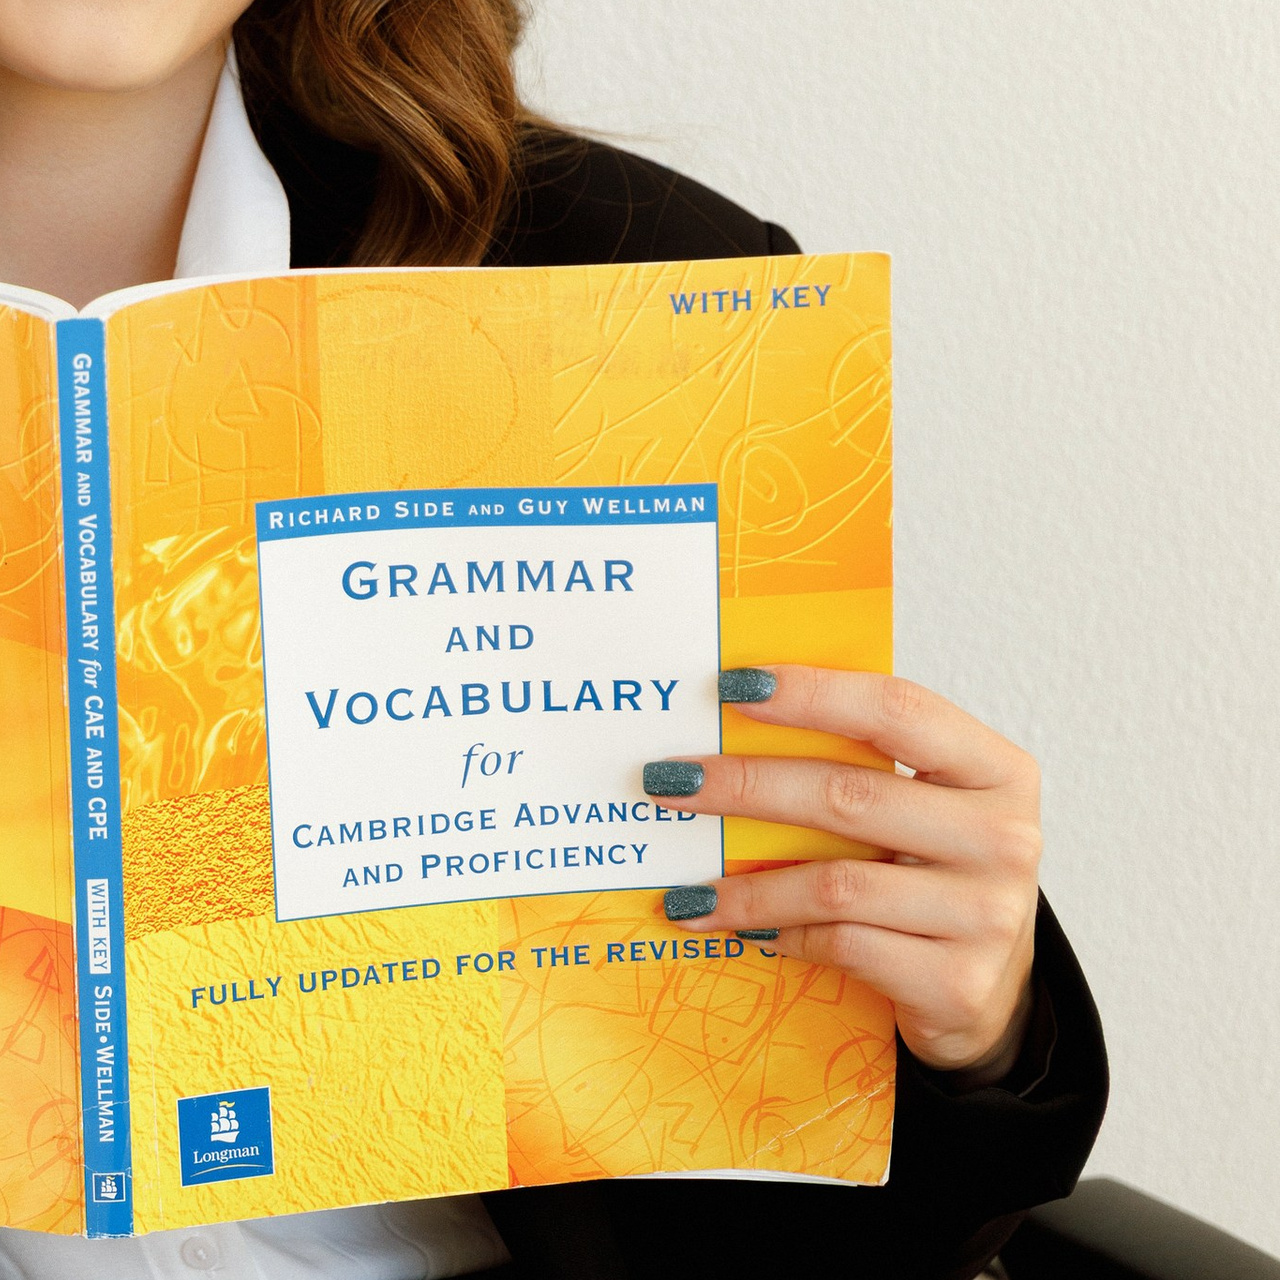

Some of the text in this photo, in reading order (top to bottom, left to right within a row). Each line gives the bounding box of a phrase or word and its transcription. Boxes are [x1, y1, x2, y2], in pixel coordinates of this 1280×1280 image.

[669, 284, 830, 315] WITH KEY
[268, 496, 705, 530] RICHARD SIDE AND GUY WELLMAN
[73, 353, 108, 841] GRAMMAR AND VOCABULARY for CAE AND CPE
[341, 559, 634, 601] GRAMMAR
[444, 623, 534, 653] AND
[304, 679, 679, 729] VOCABULARY
[461, 742, 524, 789] for
[291, 808, 496, 849] CAMBRIDGE
[342, 843, 648, 888] AND PROFICIENCY
[91, 882, 108, 971] WITH KEY
[190, 975, 282, 1009] FULLY
[298, 957, 441, 993] UPDATED
[455, 950, 516, 976] FOR
[530, 944, 590, 968] THE
[606, 937, 746, 963] REVISED
[192, 1145, 261, 1165] Longman
